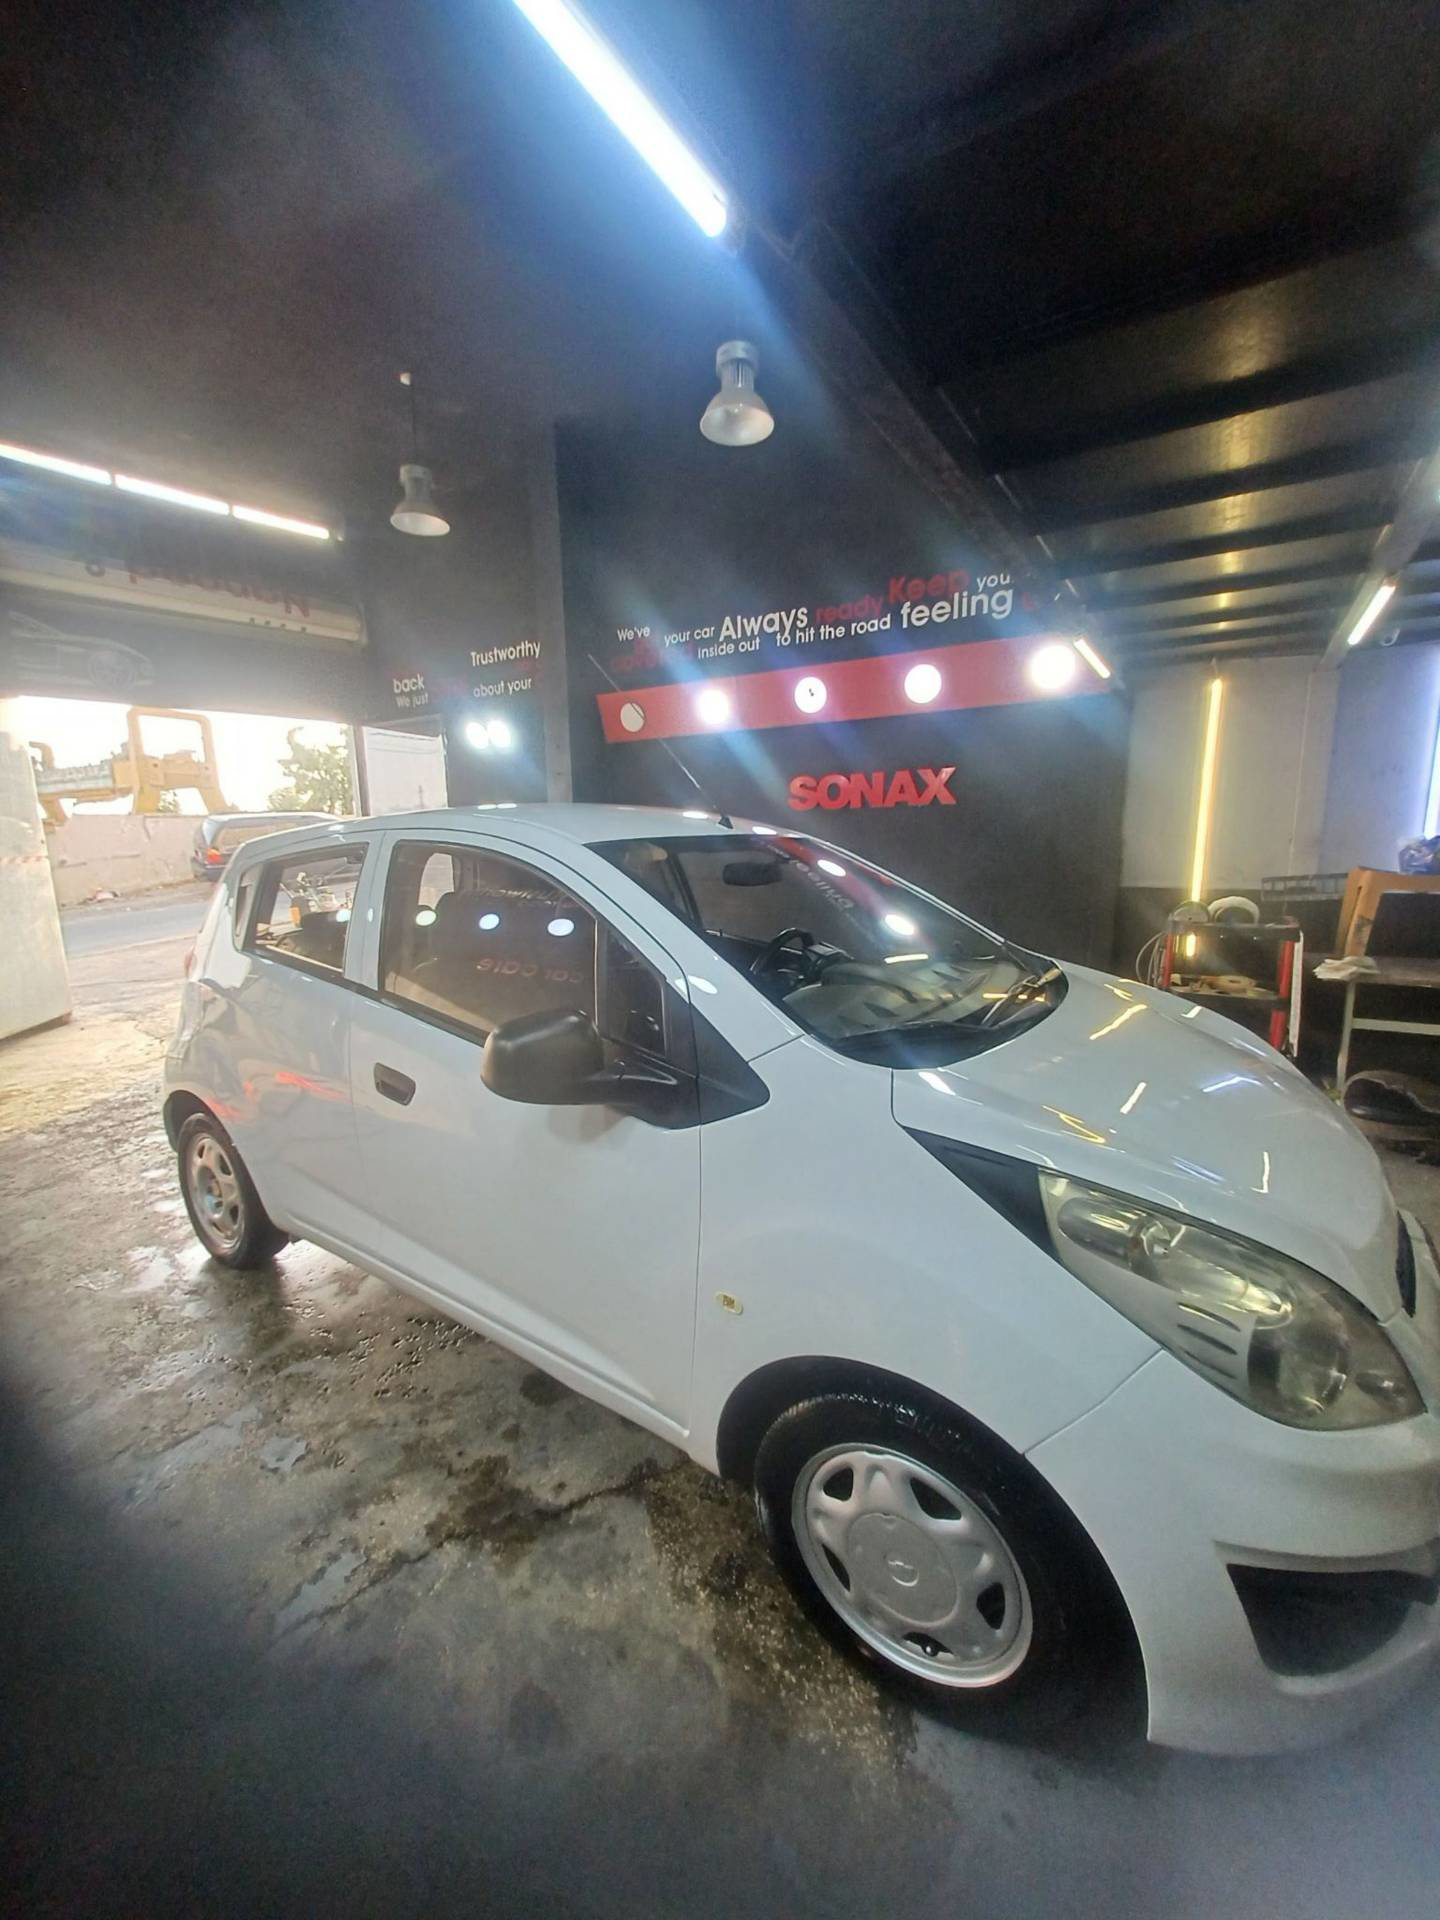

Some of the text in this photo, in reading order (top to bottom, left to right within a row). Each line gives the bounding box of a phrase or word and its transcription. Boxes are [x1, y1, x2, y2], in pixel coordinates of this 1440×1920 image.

[888, 569, 1011, 605] Keep you
[718, 594, 884, 642] Always ready
[900, 588, 1014, 630] feeling
[616, 626, 716, 647] We've your car
[775, 613, 892, 646] to hit the road
[470, 640, 541, 667] Trustworthy
[697, 641, 735, 660] inside
[738, 637, 761, 651] out
[393, 673, 425, 694] back
[473, 677, 533, 698] about your
[412, 693, 429, 708] just
[788, 766, 956, 811] SONAX
